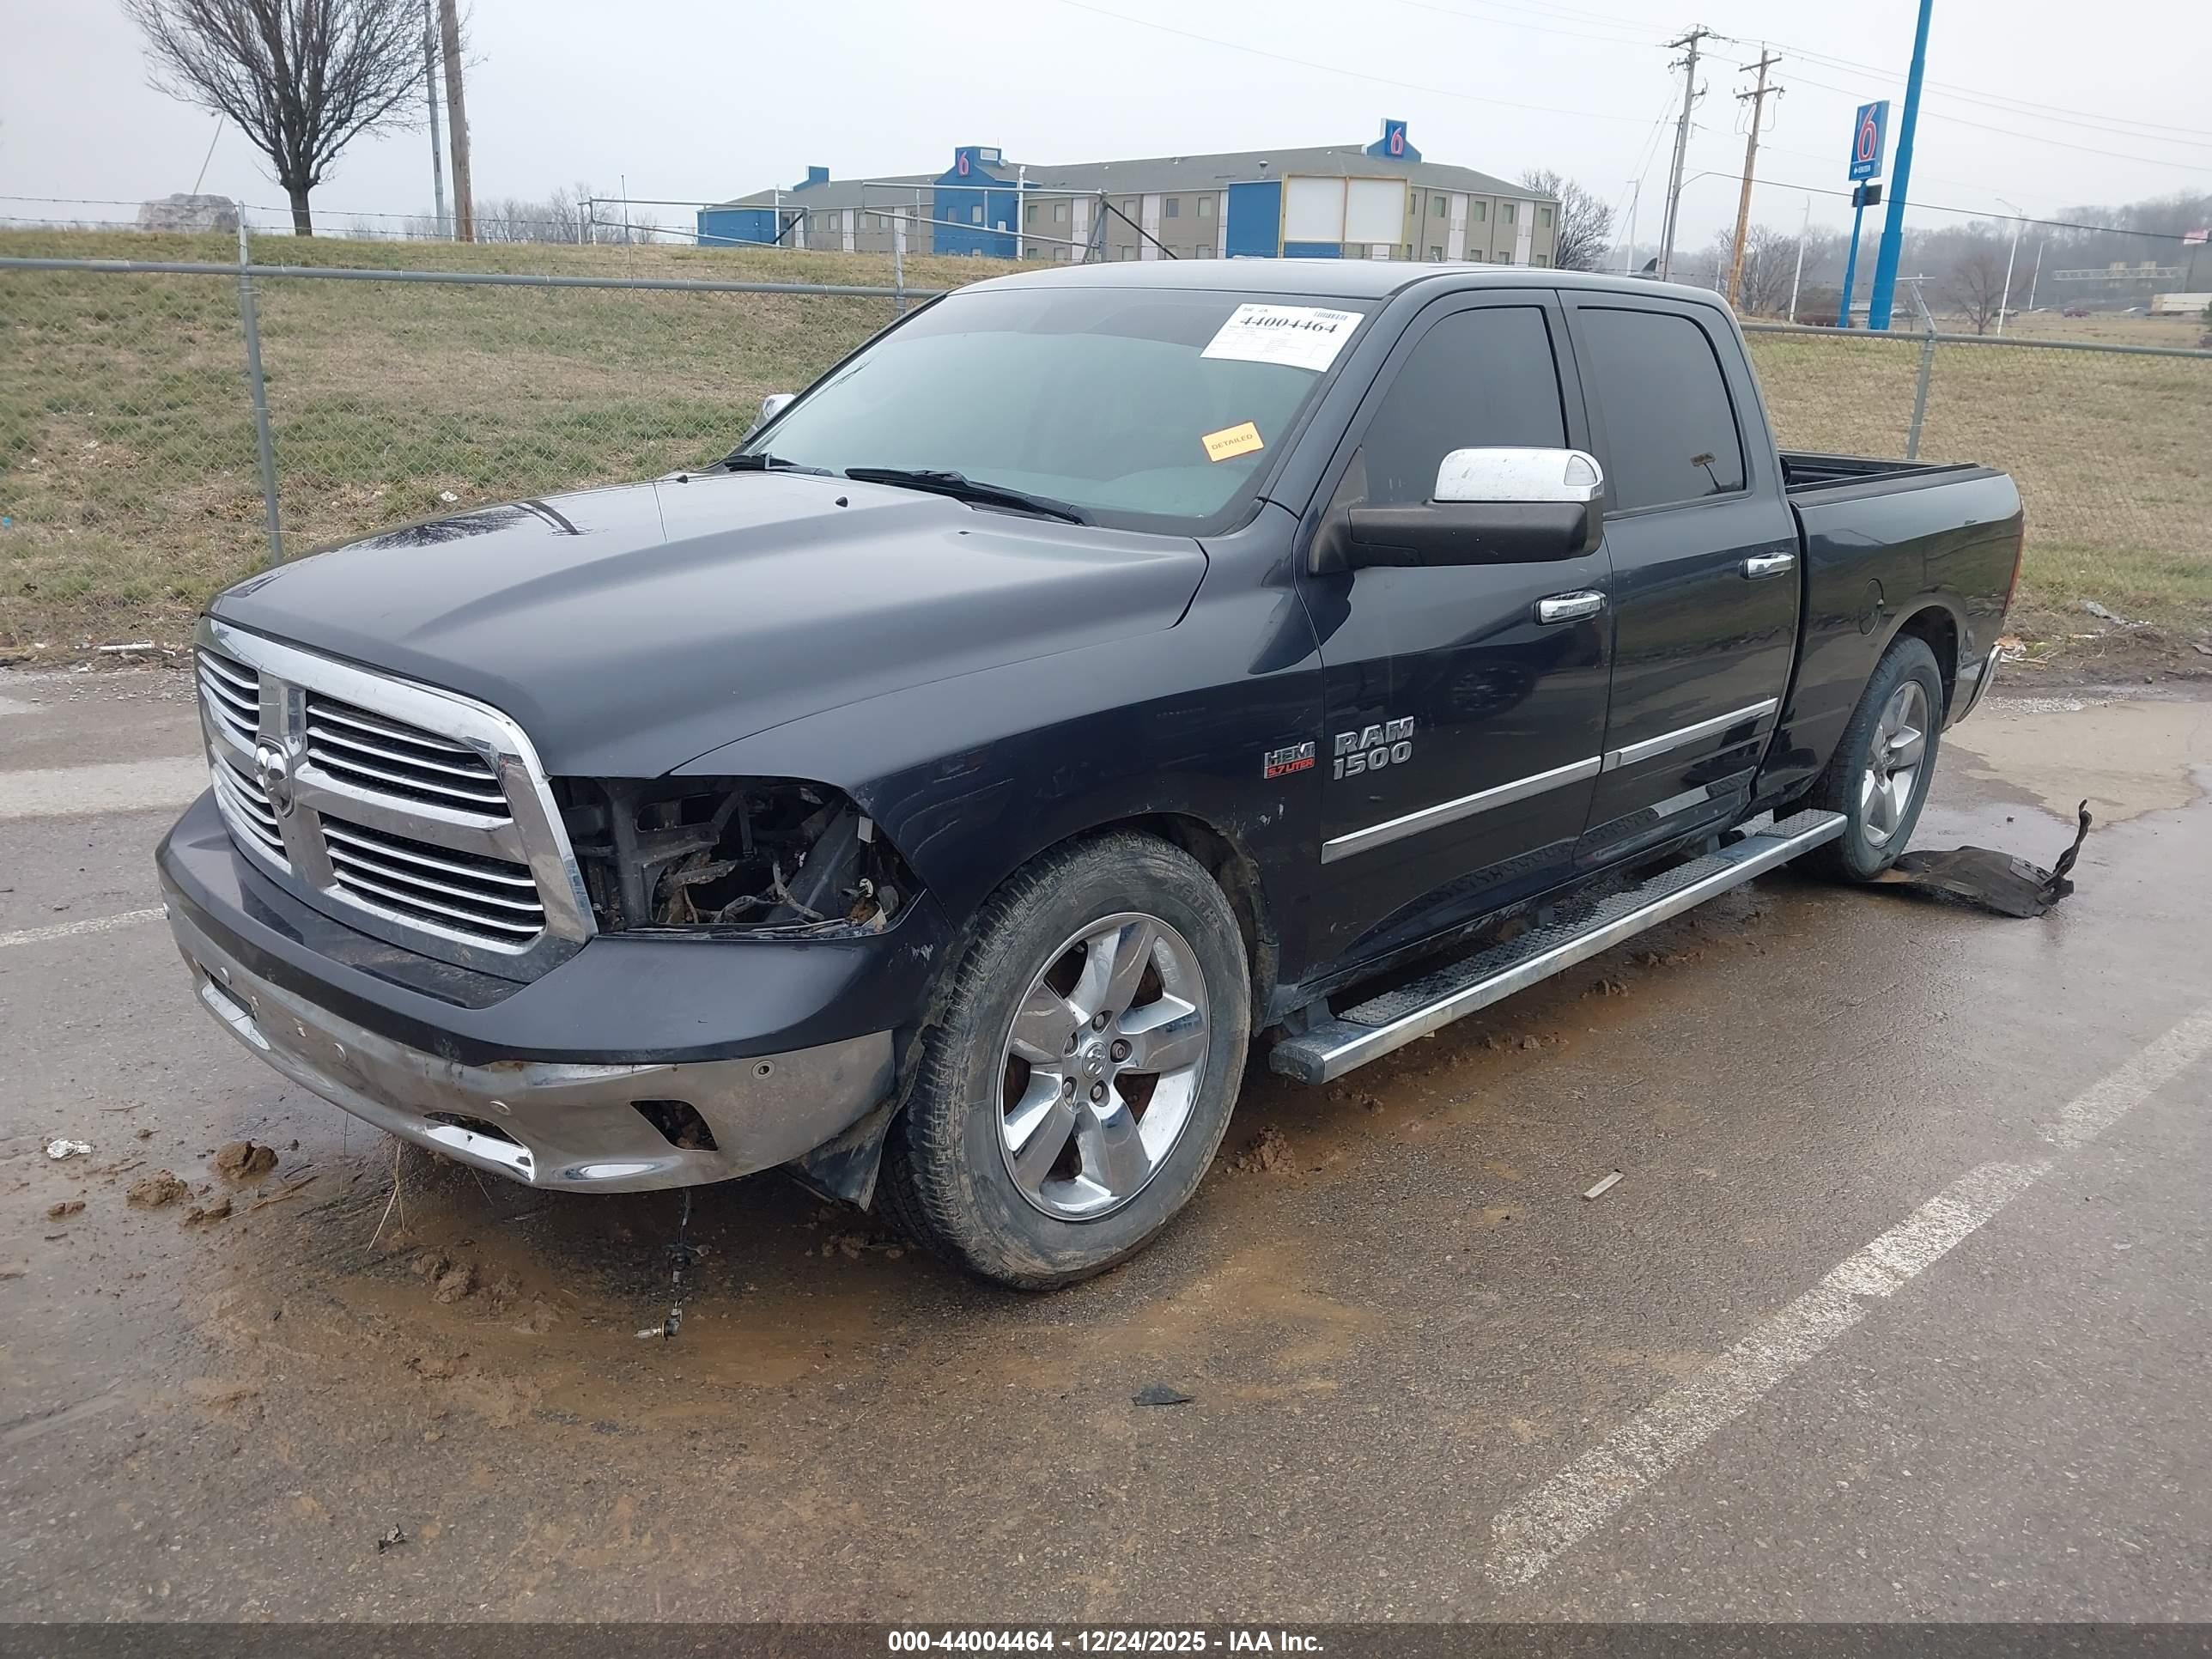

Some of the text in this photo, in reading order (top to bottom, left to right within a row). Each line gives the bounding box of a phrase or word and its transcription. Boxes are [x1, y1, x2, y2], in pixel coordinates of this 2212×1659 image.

[1390, 126, 1403, 155] 6
[1857, 104, 1877, 161] 6
[958, 150, 969, 177] 6
[1240, 315, 1338, 334] 44004464
[1211, 433, 1253, 450] DETAILED
[1334, 715, 1414, 757] RAM
[1264, 741, 1316, 768] HEMI
[1333, 740, 1413, 781] 1500
